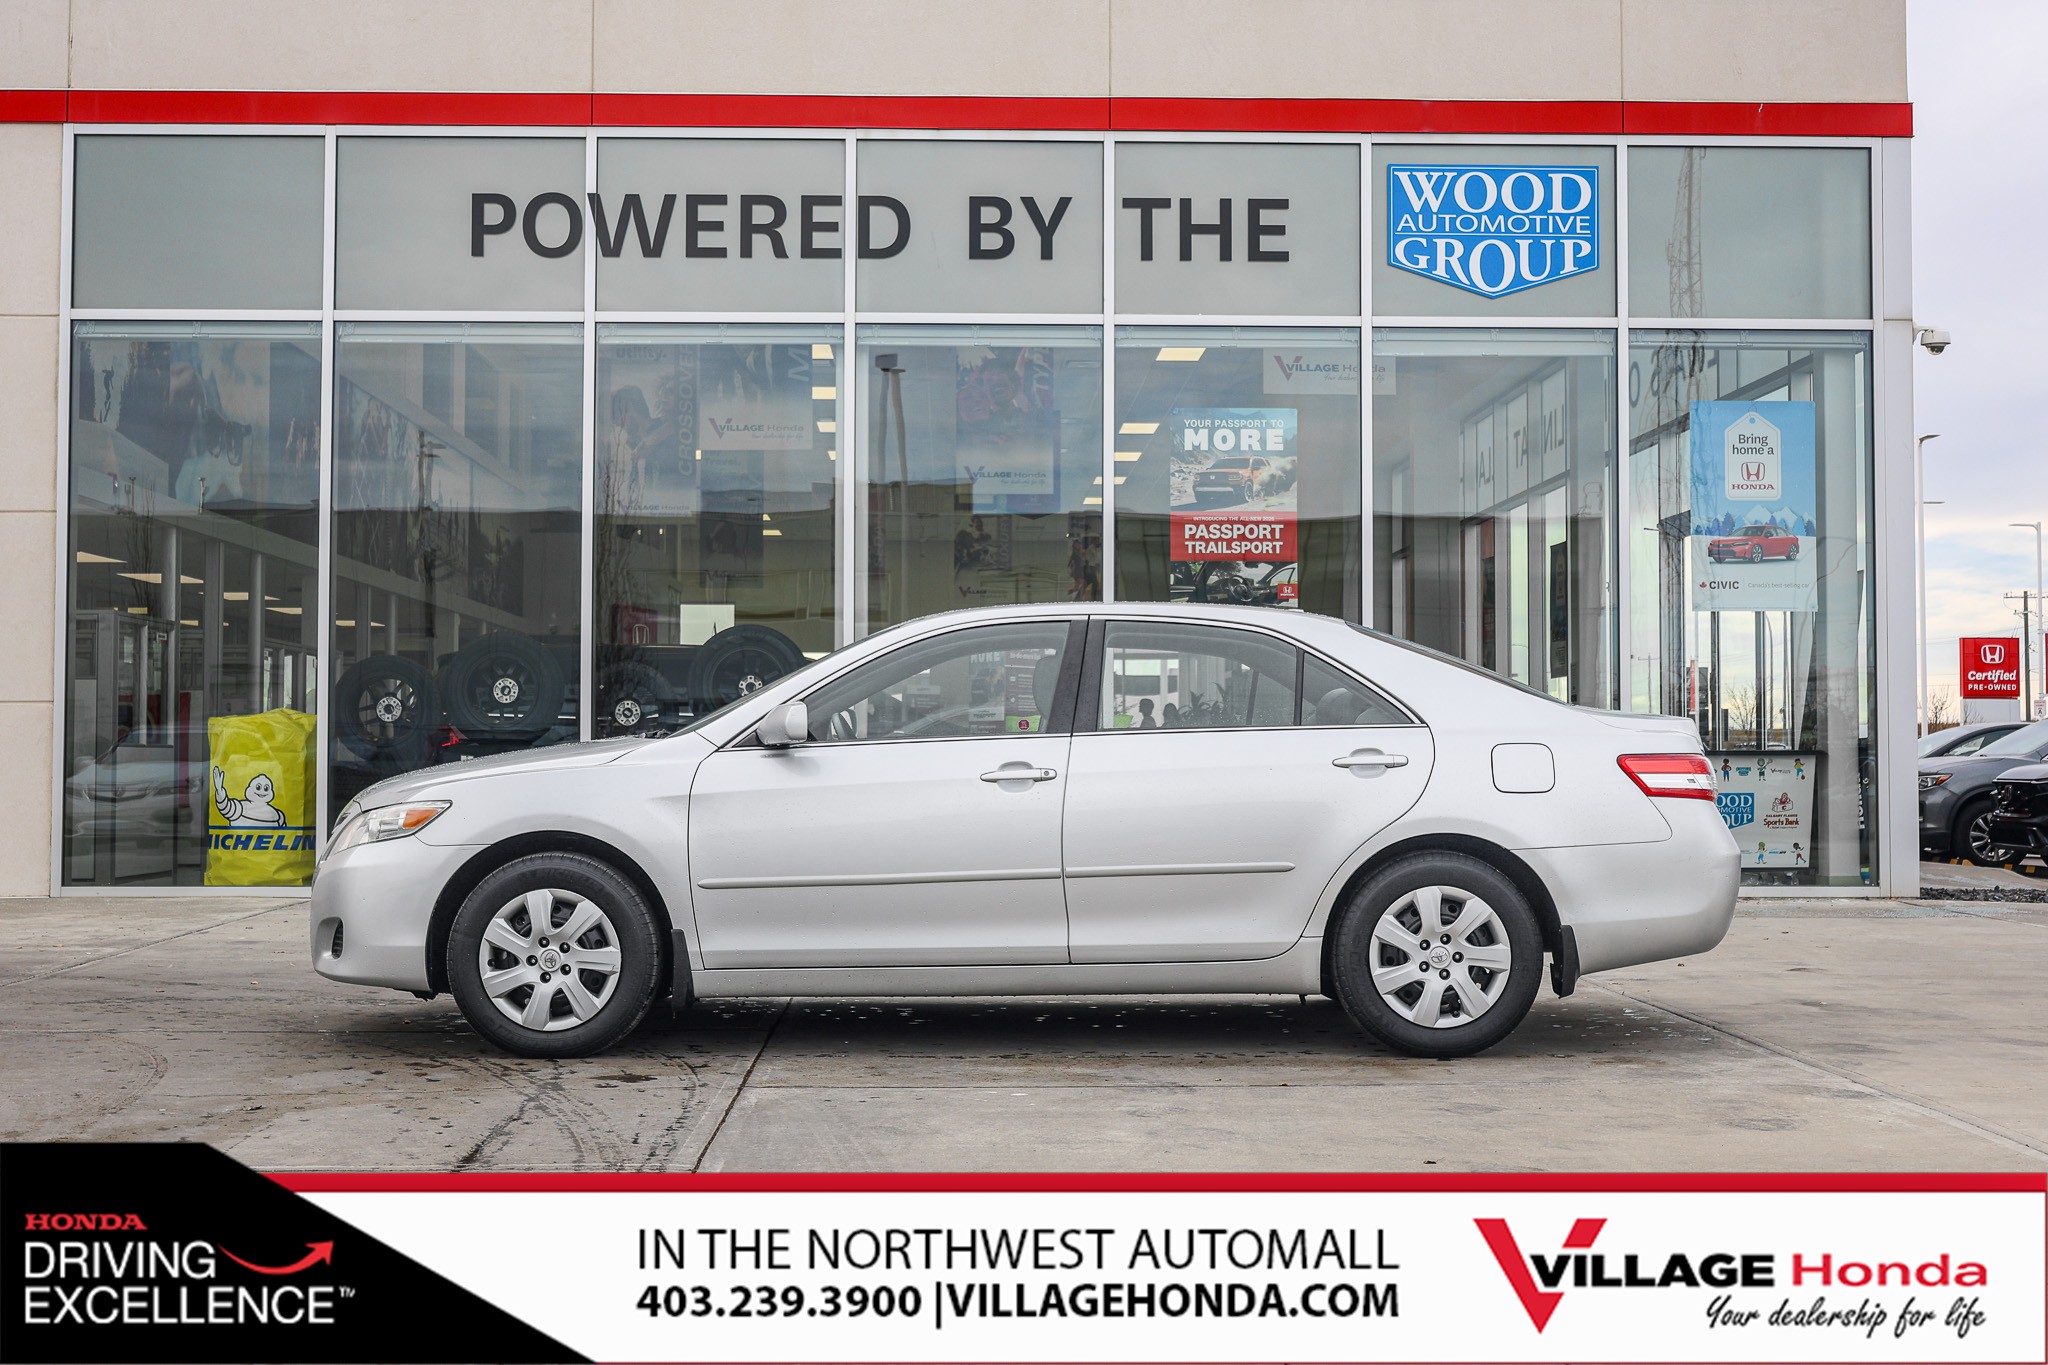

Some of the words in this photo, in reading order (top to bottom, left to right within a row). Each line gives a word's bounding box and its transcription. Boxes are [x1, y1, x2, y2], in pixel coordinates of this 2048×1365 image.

[1394, 171, 1592, 214] WOOD
[471, 191, 911, 260] POWERED
[968, 196, 1072, 261] BY
[1122, 197, 1290, 263] THE
[1396, 213, 1591, 234] AUTOMOTIVE
[1394, 237, 1592, 293] GROUP
[1342, 364, 1386, 373] Hoda
[1183, 419, 1212, 428] YOUR
[1214, 419, 1267, 428] PASSPORT
[1271, 419, 1285, 428] TO
[1184, 428, 1283, 451] MORE
[1738, 433, 1769, 447] Bring
[1732, 444, 1765, 456] home
[1767, 446, 1775, 456] a
[1731, 483, 1776, 491] HONDA
[1184, 523, 1284, 540] PASSPORT
[1185, 541, 1283, 554] TRAILSPORT
[1709, 580, 1740, 591] CIVIC
[1967, 670, 2016, 682] Certified
[1716, 794, 1753, 808] OOD
[1721, 813, 1753, 828] OUP
[1763, 818, 1784, 828] Sports
[1785, 817, 1800, 826] Bank
[208, 833, 316, 851] ICHELIN
